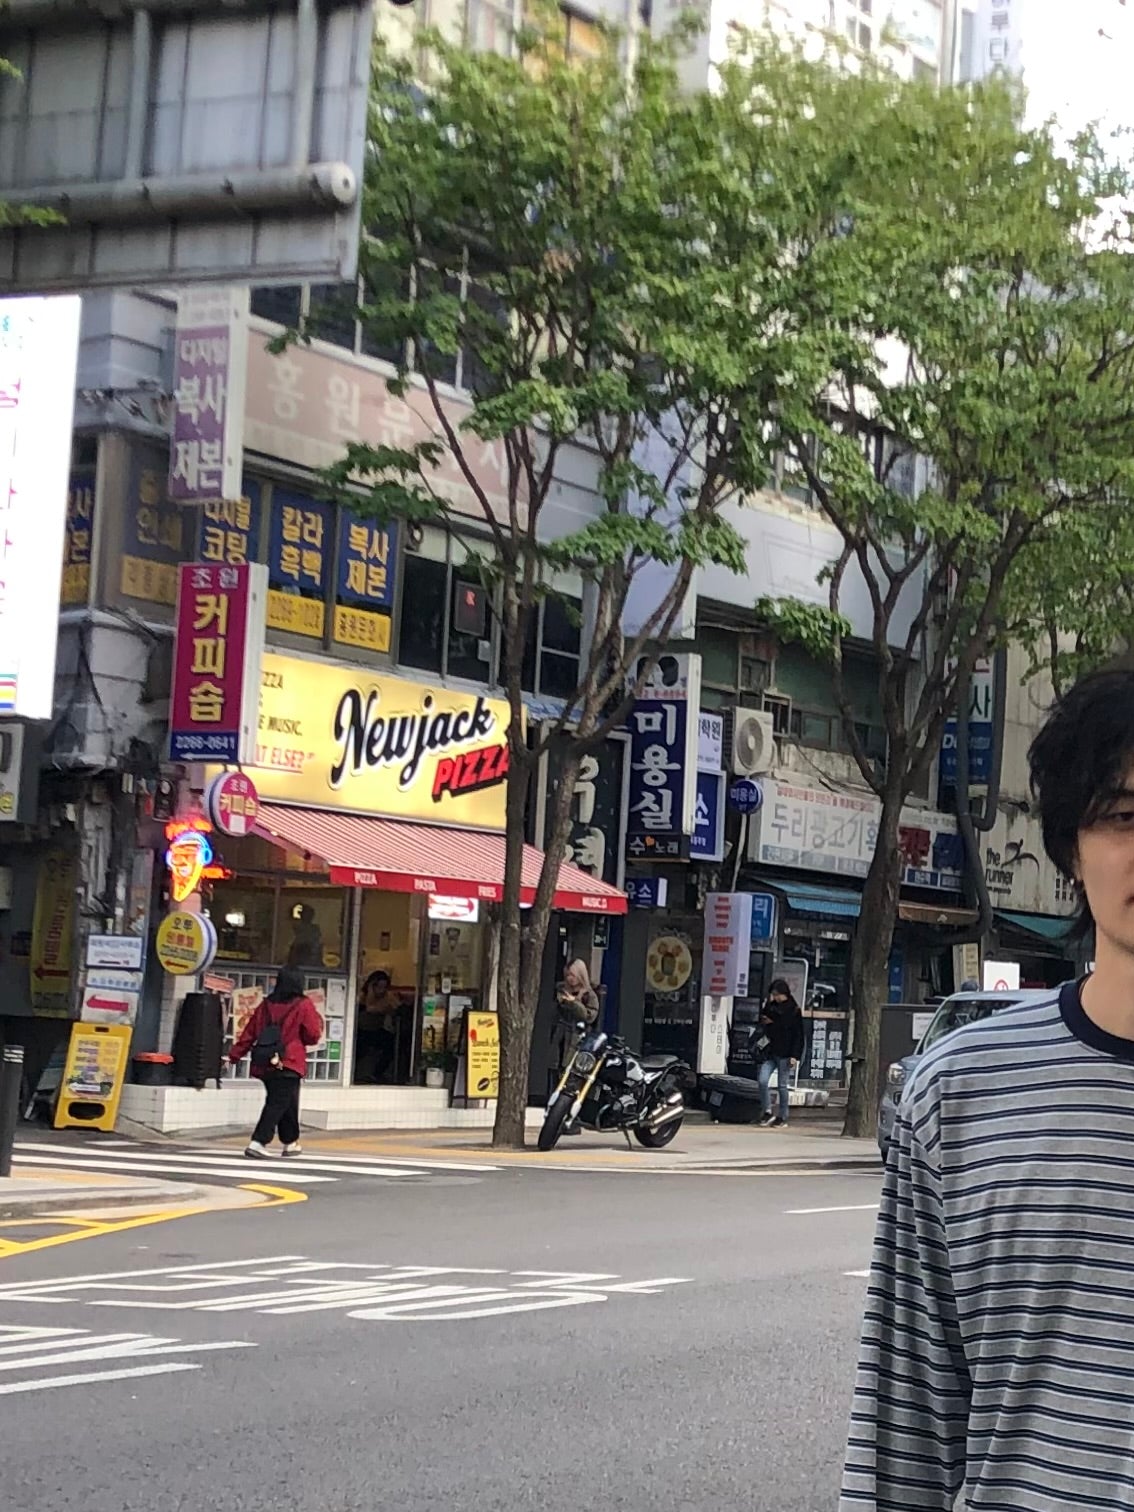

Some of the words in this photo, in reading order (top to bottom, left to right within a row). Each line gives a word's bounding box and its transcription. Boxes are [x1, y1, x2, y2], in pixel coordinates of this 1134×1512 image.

[178, 374, 223, 425] 복사
[173, 438, 222, 491] 제본
[203, 526, 247, 565] 코팅
[282, 506, 324, 549] 칼라
[349, 523, 389, 565] 복사
[346, 559, 387, 599] 제본
[331, 689, 495, 786] Newjack
[697, 718, 722, 741] 학원
[630, 703, 681, 830] 미용실
[730, 788, 757, 801] 미용실
[986, 847, 1001, 866] the
[353, 871, 378, 886] PIZZA
[413, 878, 437, 892] PASTA
[985, 868, 1014, 887] runner
